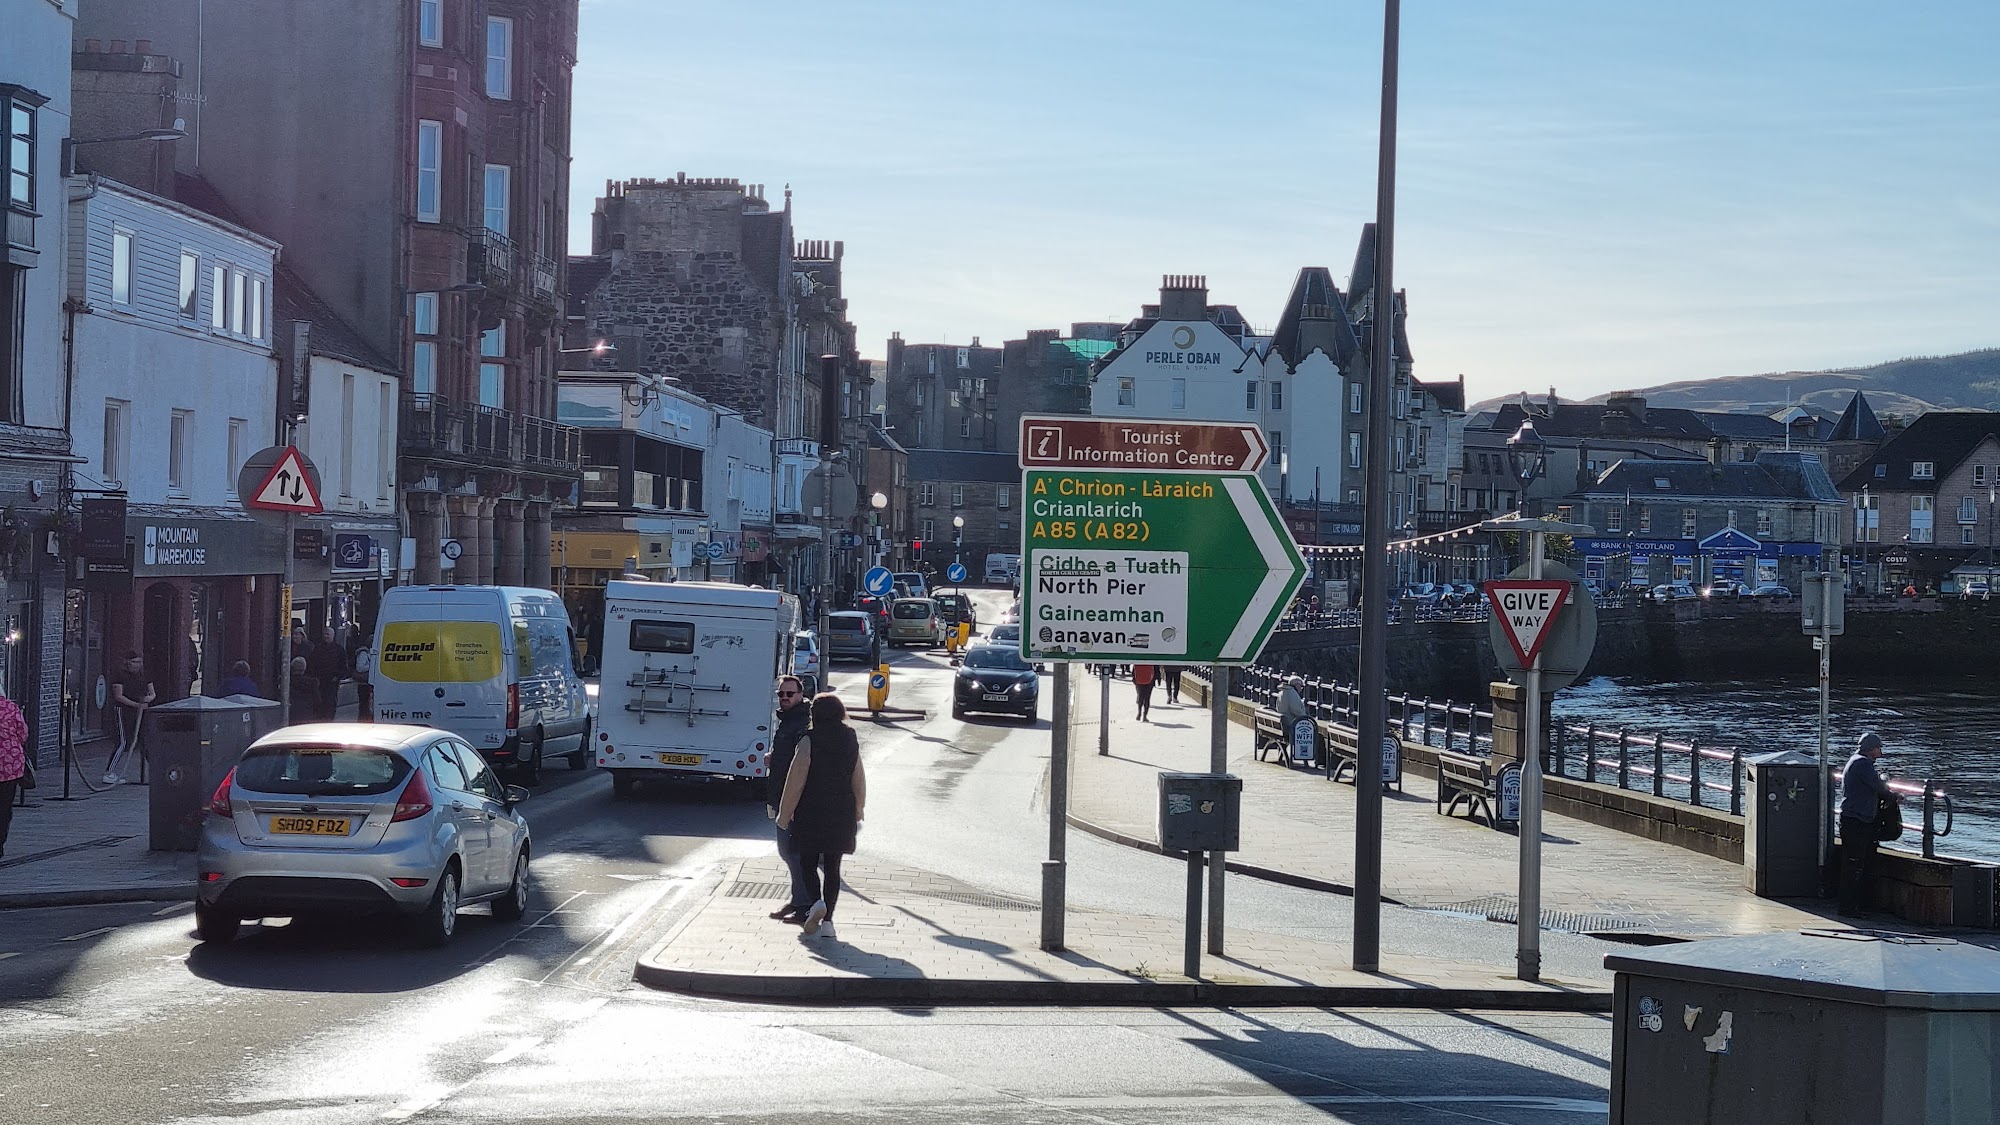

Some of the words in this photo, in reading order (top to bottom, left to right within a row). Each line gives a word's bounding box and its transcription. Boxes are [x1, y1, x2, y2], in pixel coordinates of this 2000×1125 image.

[1146, 351, 1183, 363] PERLE
[1187, 352, 1221, 364] OBAN
[1121, 428, 1181, 446] Tourist
[1067, 445, 1169, 464] Information
[1175, 449, 1235, 467] Centre
[1058, 477, 1126, 497] Chrìon
[1142, 479, 1214, 499] Làraich
[1032, 499, 1143, 519] Crianlarich
[157, 526, 199, 544] MOUNTAIN
[1635, 542, 1675, 551] SCOTLAND
[157, 548, 206, 565] WAREHOUSE
[1039, 555, 1099, 571] Cidhe
[1105, 560, 1117, 573] a
[1123, 556, 1181, 575] Tuath
[1039, 577, 1098, 595] North
[1107, 578, 1146, 596] Pier
[1503, 592, 1549, 611] GIVE
[1038, 604, 1165, 623] Gaineamhan
[1512, 615, 1542, 628] WAY
[384, 642, 435, 652] Arnold
[384, 653, 423, 662] Clark
[381, 709, 408, 719] Hire
[412, 711, 432, 719] me
[661, 755, 683, 763] PX08
[277, 817, 314, 833] SH09
[316, 819, 345, 833] FDZ
